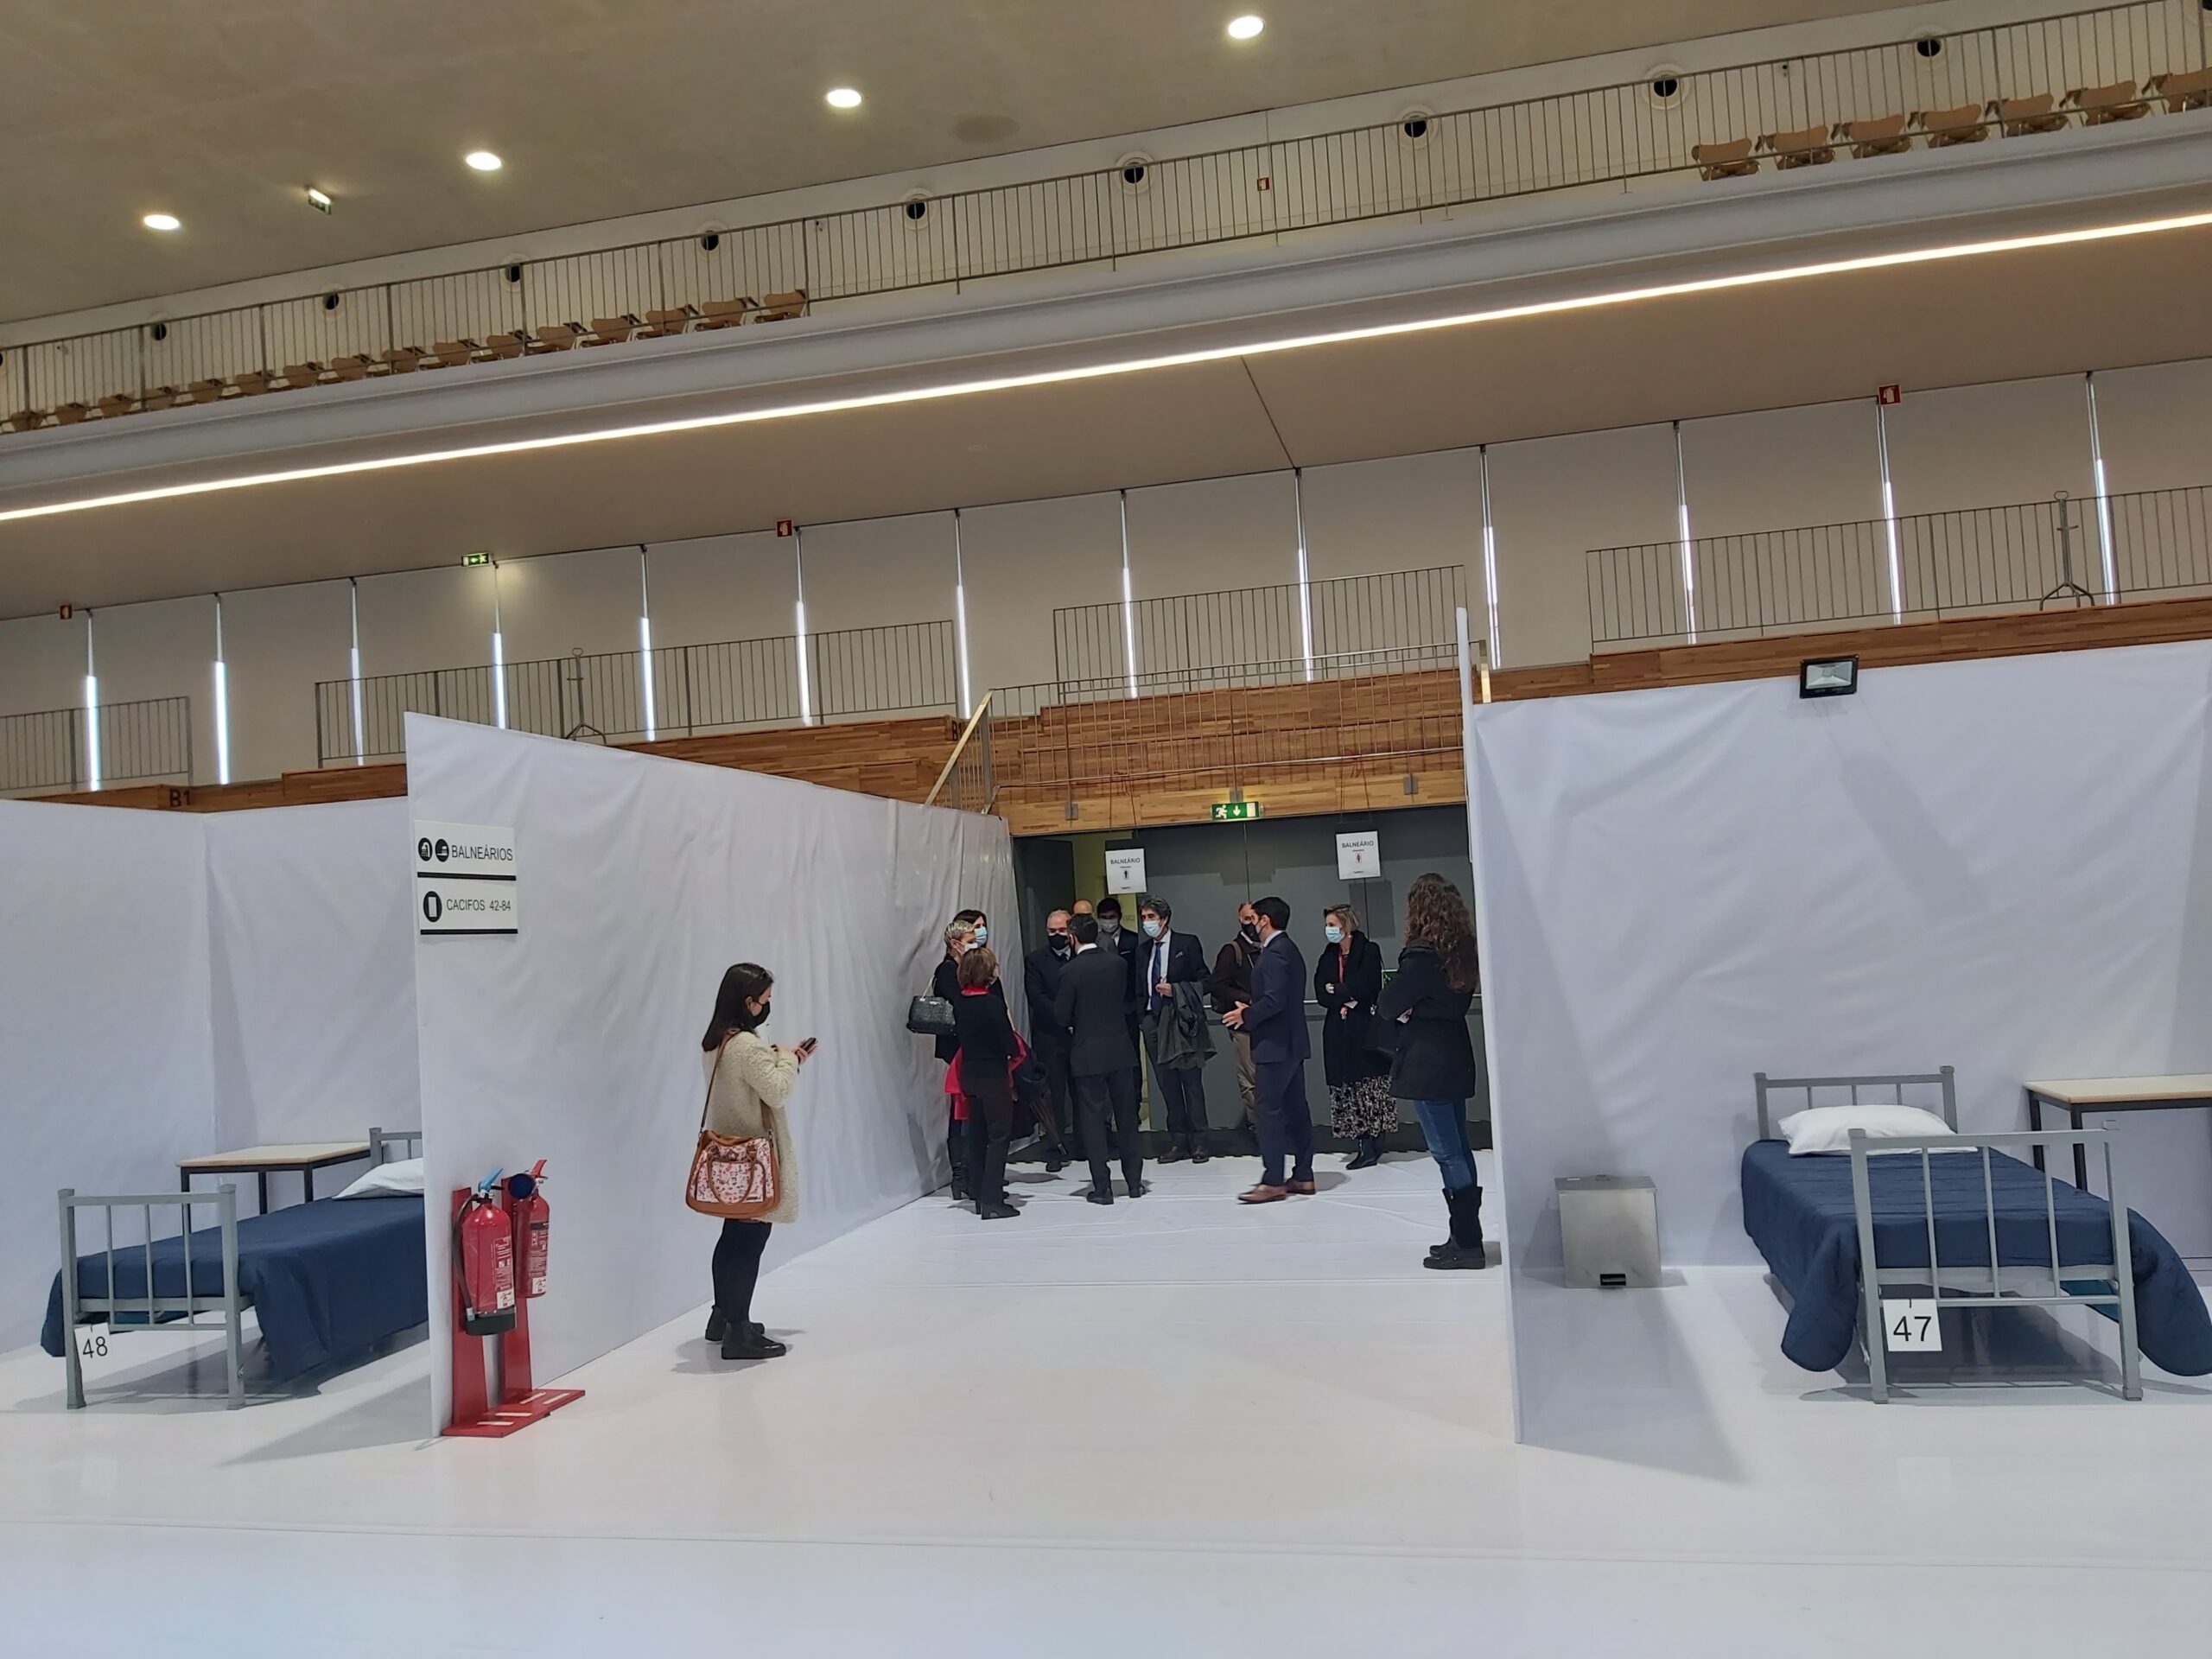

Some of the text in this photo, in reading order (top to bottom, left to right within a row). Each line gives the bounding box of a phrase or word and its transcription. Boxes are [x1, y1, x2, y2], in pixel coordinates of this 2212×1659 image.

[169, 788, 191, 807] B1
[451, 844, 513, 861] BALNEÁRIOS
[1342, 839, 1374, 849] BALNEÁRIO
[446, 899, 512, 912] CACIFOS 42-84
[1893, 1315, 1932, 1342] 47
[82, 1336, 108, 1359] 48
